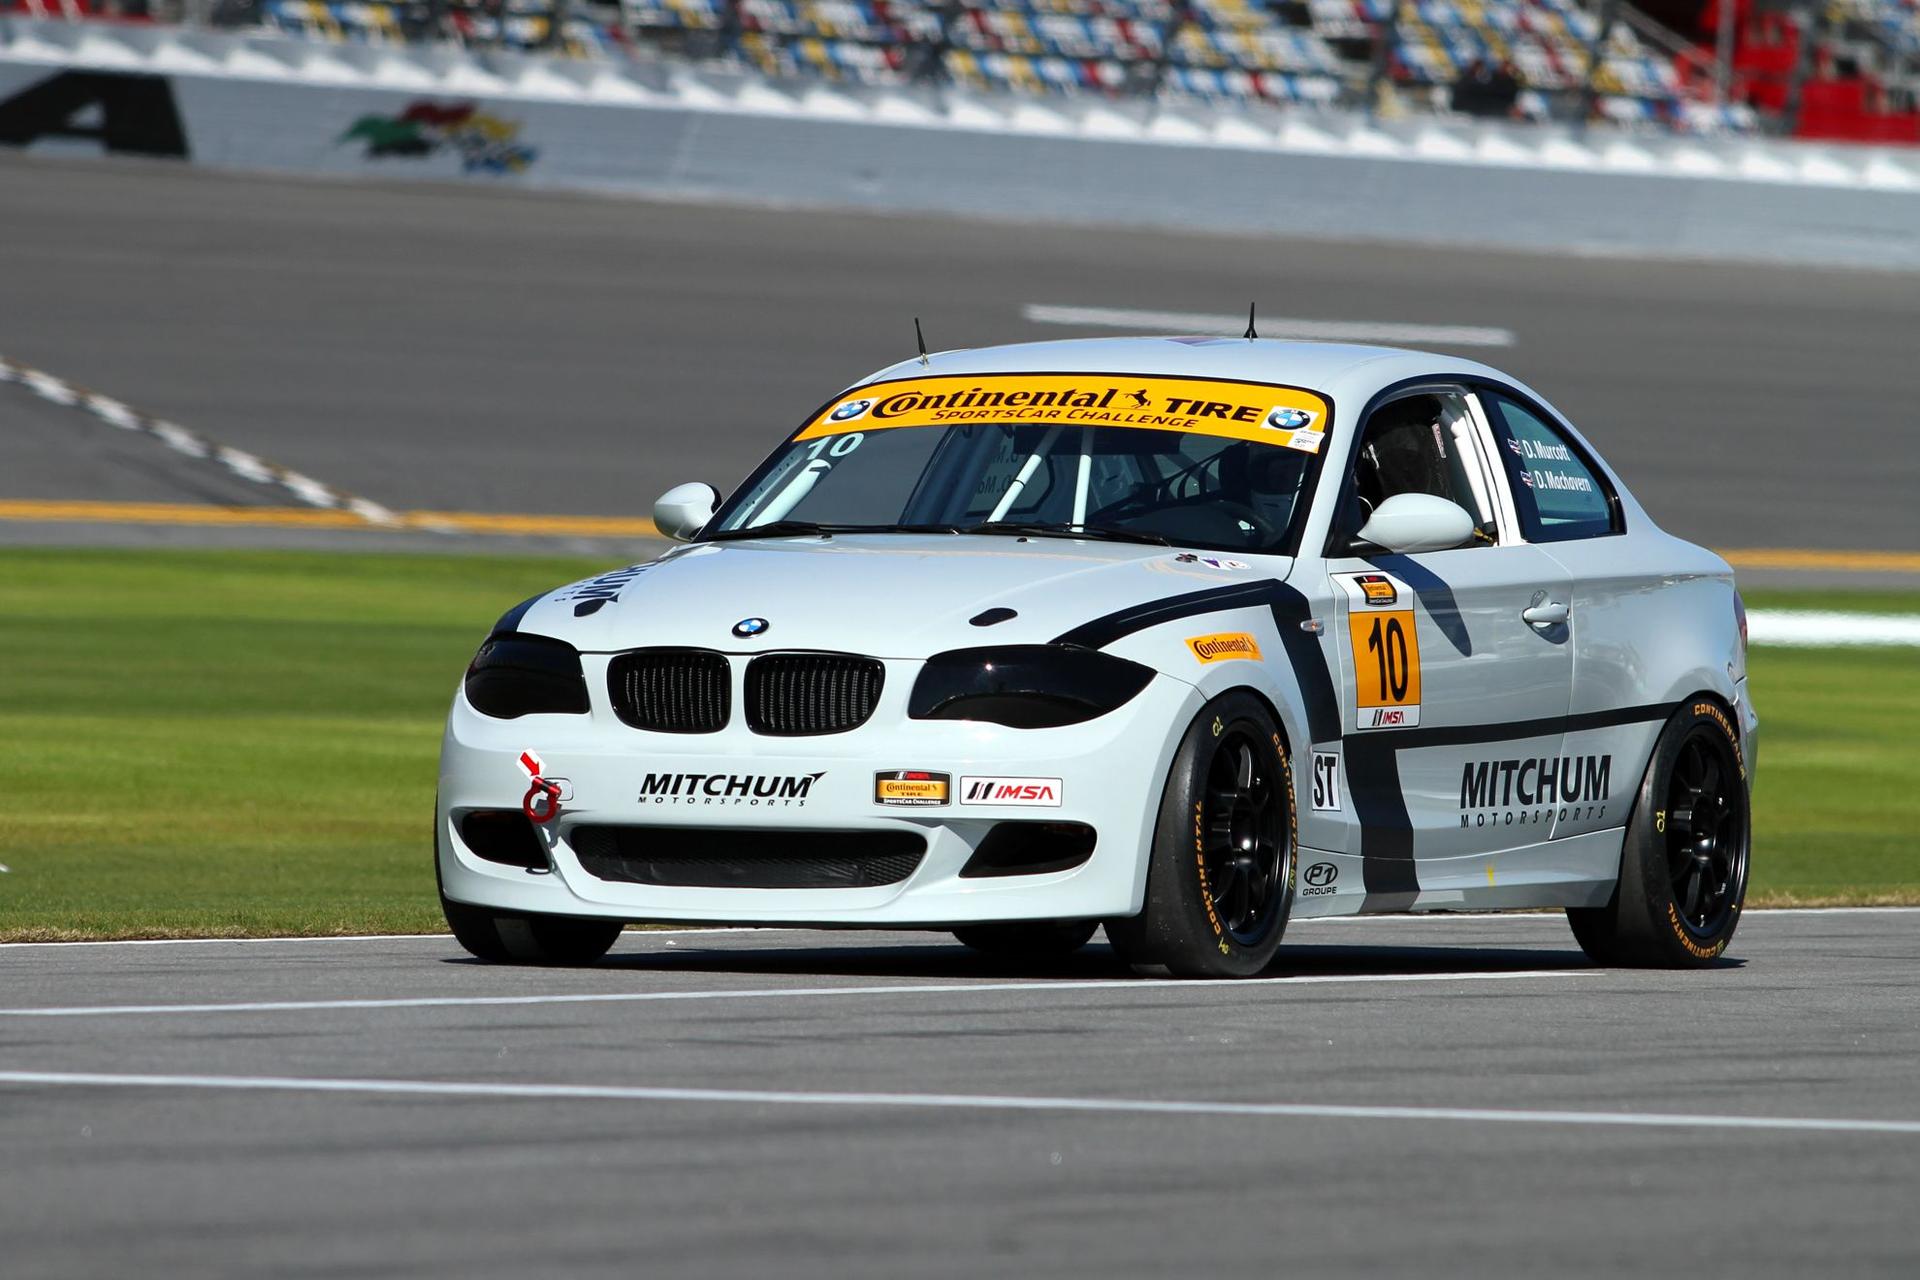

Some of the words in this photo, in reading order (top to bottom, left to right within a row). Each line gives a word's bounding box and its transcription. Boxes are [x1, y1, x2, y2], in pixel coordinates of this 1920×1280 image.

[872, 388, 1119, 418] Continental
[1166, 398, 1263, 423] TIRE
[930, 408, 1061, 420] SPORTSCAR
[1066, 409, 1198, 428] CHALLENGE
[807, 433, 864, 460] 10
[1522, 440, 1537, 459] D.
[1536, 441, 1571, 461] Murcott
[1535, 470, 1548, 489] D.
[1193, 637, 1249, 659] Continental
[1368, 617, 1408, 702] 10
[1382, 711, 1404, 725] IMSA
[640, 773, 815, 798] MITCHUM
[886, 782, 931, 792] Continental
[1313, 755, 1336, 808] ST
[1460, 755, 1611, 809] MITCHUM
[638, 796, 806, 807] MOTORSPORTS
[995, 785, 1054, 800] IMSA
[1461, 805, 1606, 828] MOTORSPORTS
[1308, 865, 1334, 884] P1
[1302, 887, 1337, 896] GROUPE
